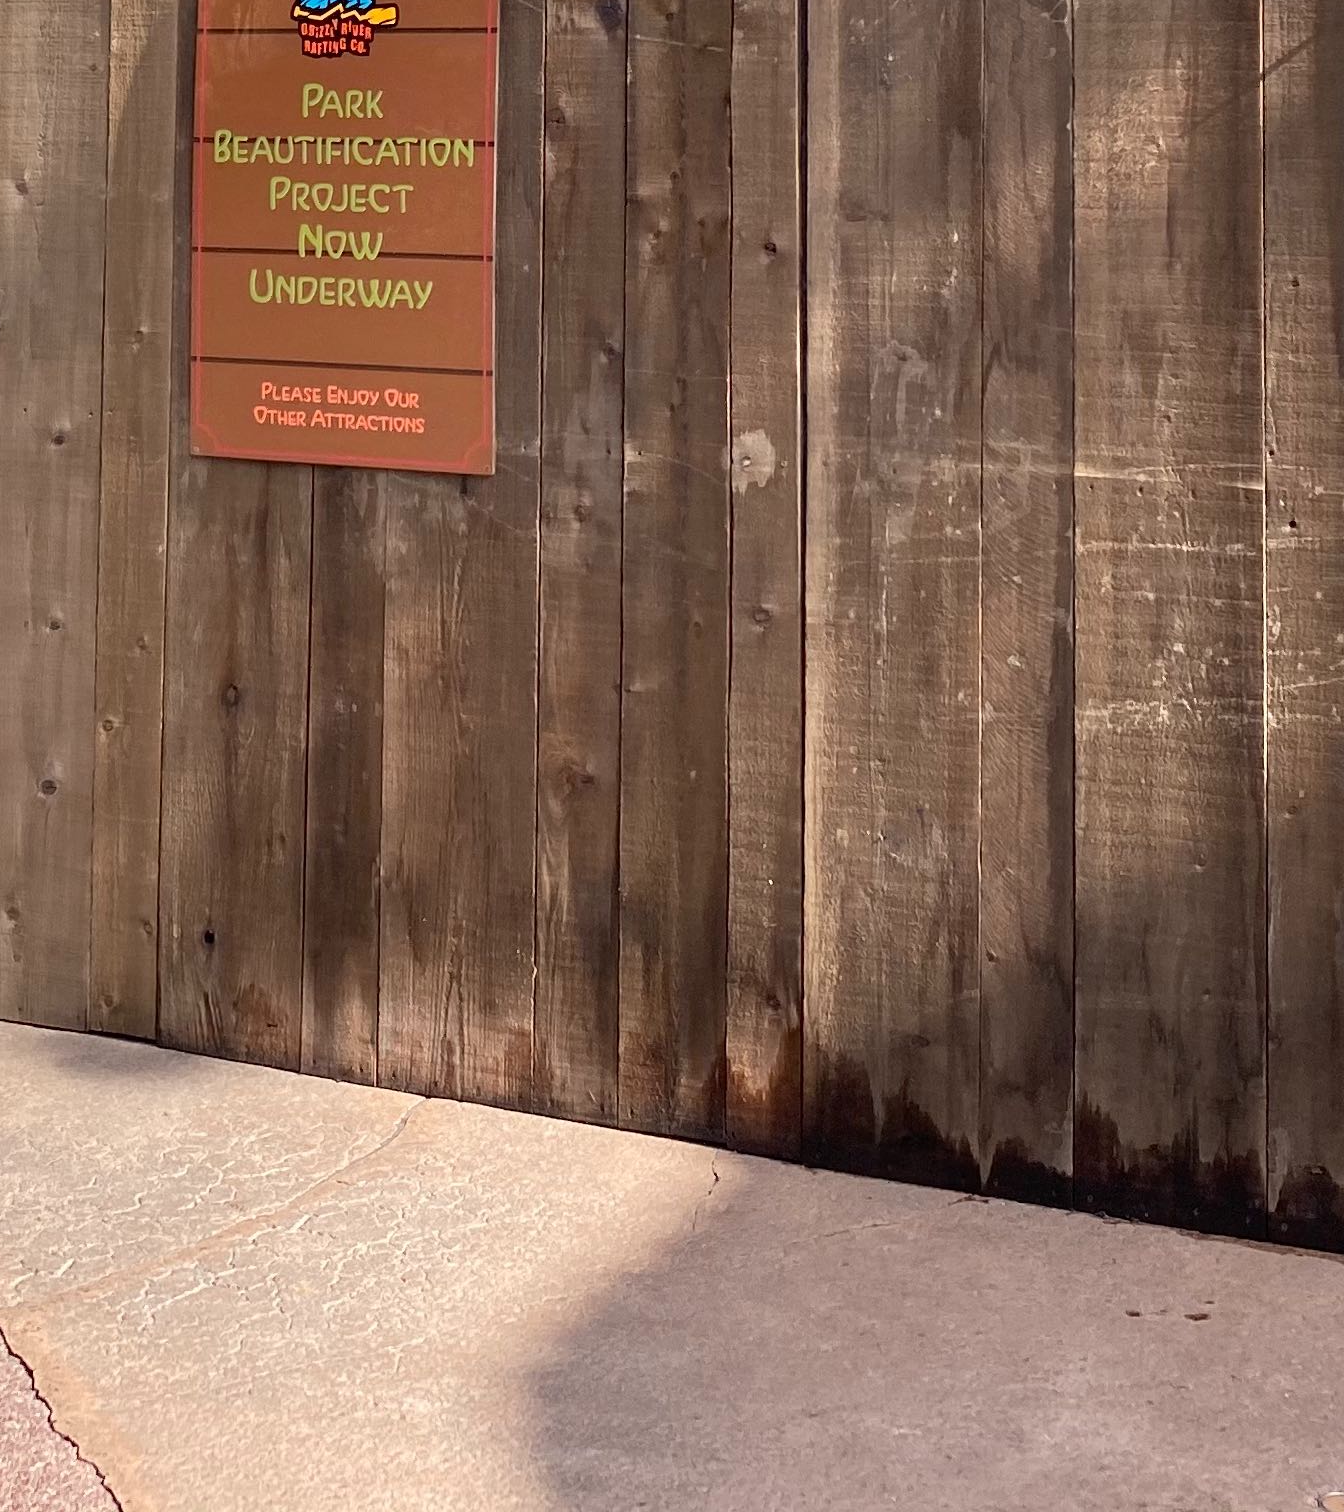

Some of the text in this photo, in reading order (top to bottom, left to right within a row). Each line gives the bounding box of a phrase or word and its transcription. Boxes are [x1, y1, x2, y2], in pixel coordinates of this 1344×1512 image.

[304, 37, 346, 55] RAFTING
[341, 20, 372, 39] RIVER
[302, 83, 384, 119] PARK
[213, 129, 475, 168] BEAUTIFICATION
[269, 176, 414, 214] PROJECT
[298, 224, 384, 261] NOW
[248, 269, 433, 310] UNDERWAY
[261, 382, 420, 409] PLEASE ENJOY OUR
[253, 406, 426, 434] OTHER ATTRACTIONS
